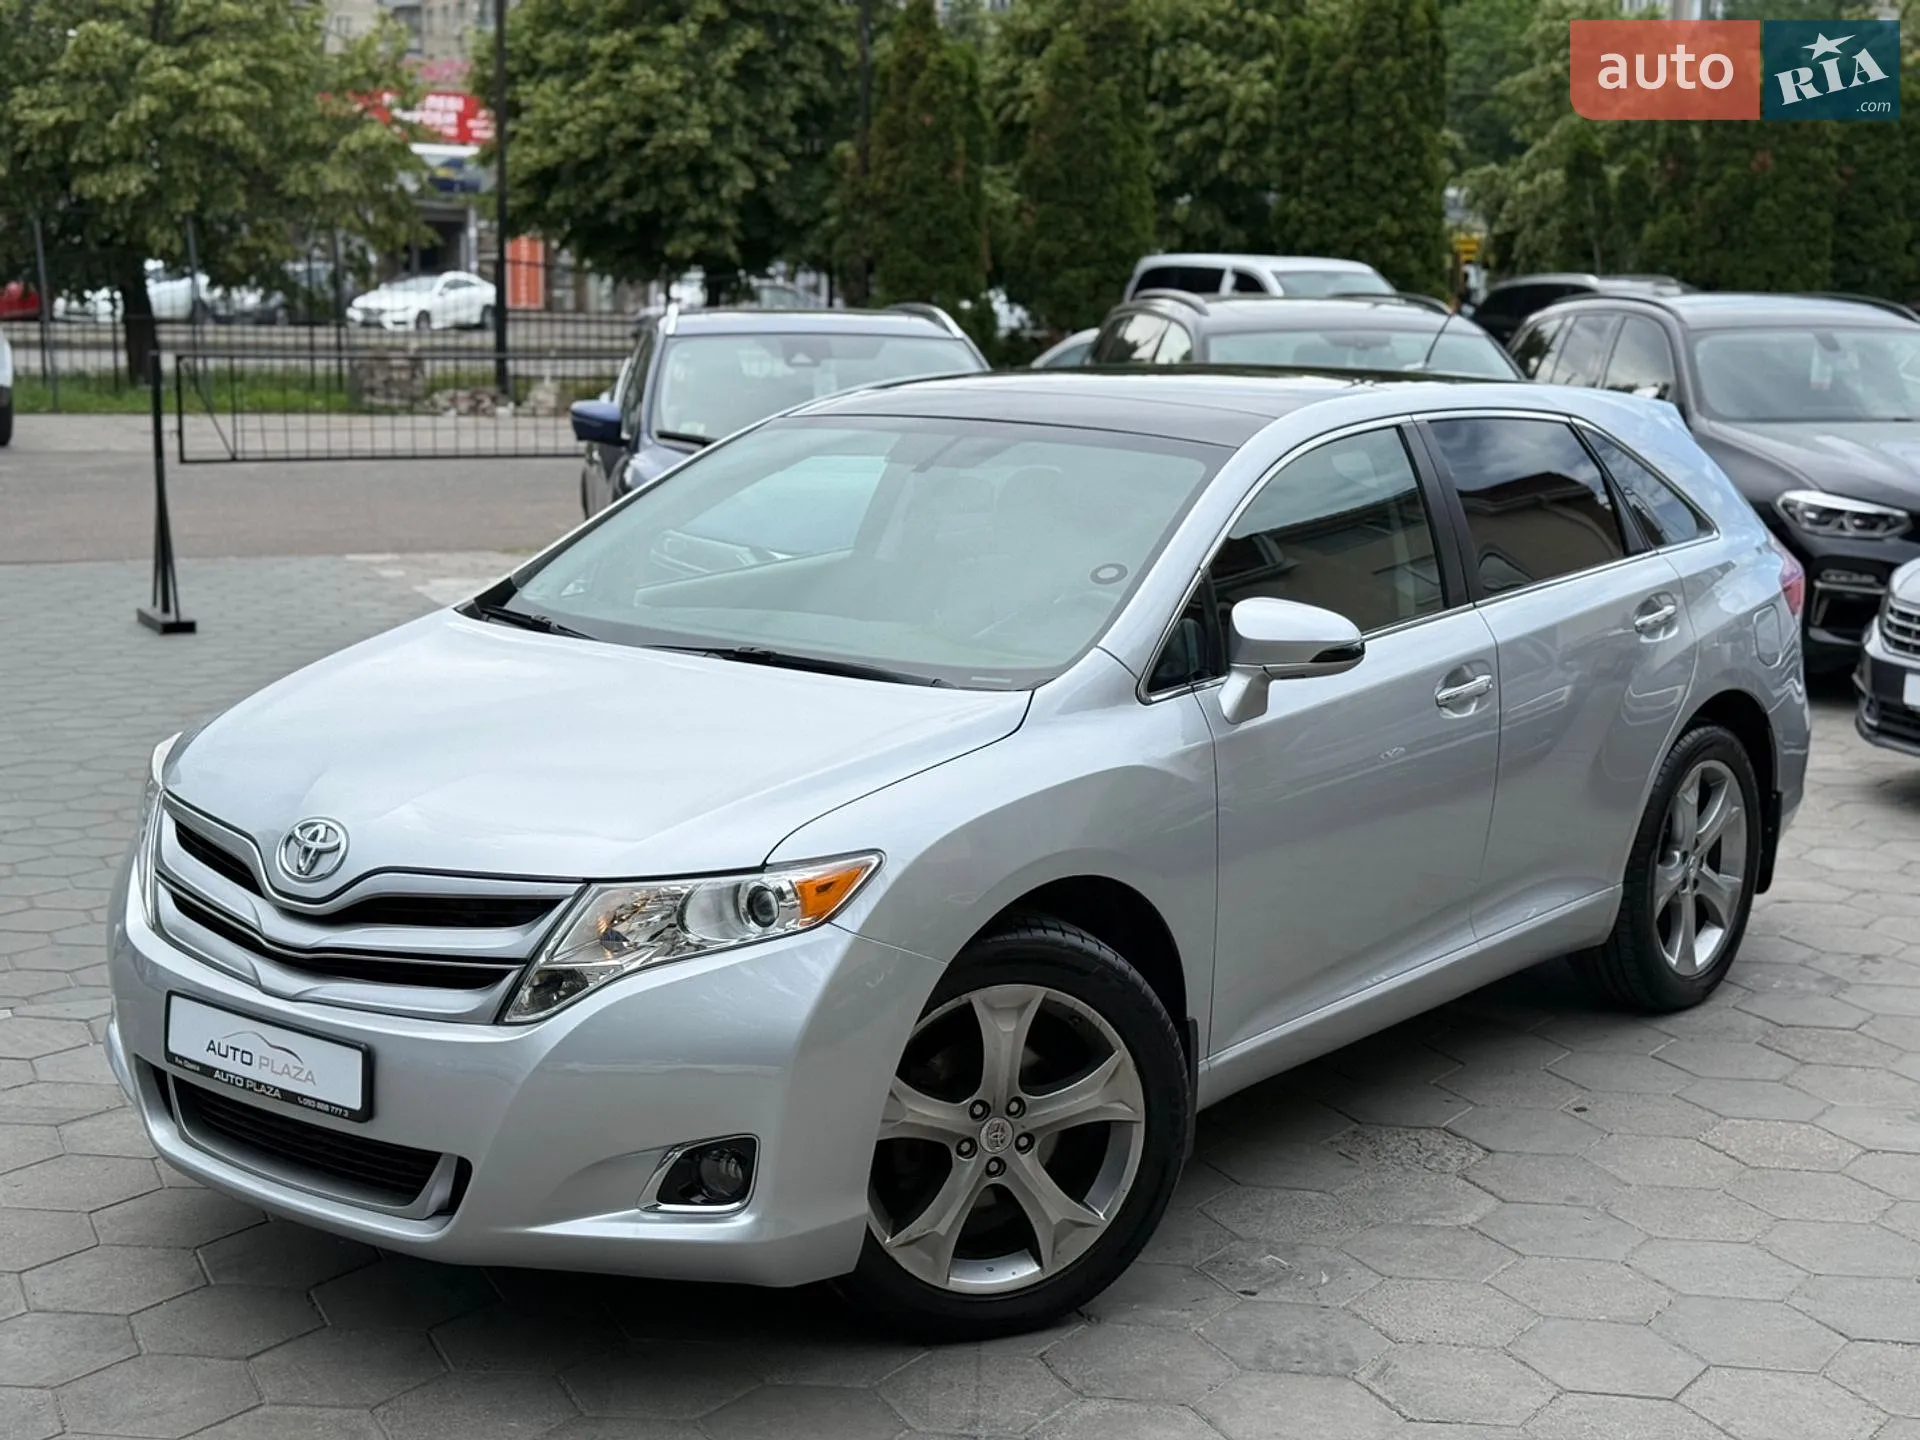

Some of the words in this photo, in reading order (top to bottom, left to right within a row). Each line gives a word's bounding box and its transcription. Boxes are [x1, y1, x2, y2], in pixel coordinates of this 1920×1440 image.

[206, 1039, 253, 1066] AUTO
[258, 1055, 317, 1087] PLAZA
[213, 1069, 245, 1088] AUTO
[246, 1079, 282, 1100] PLAZA
